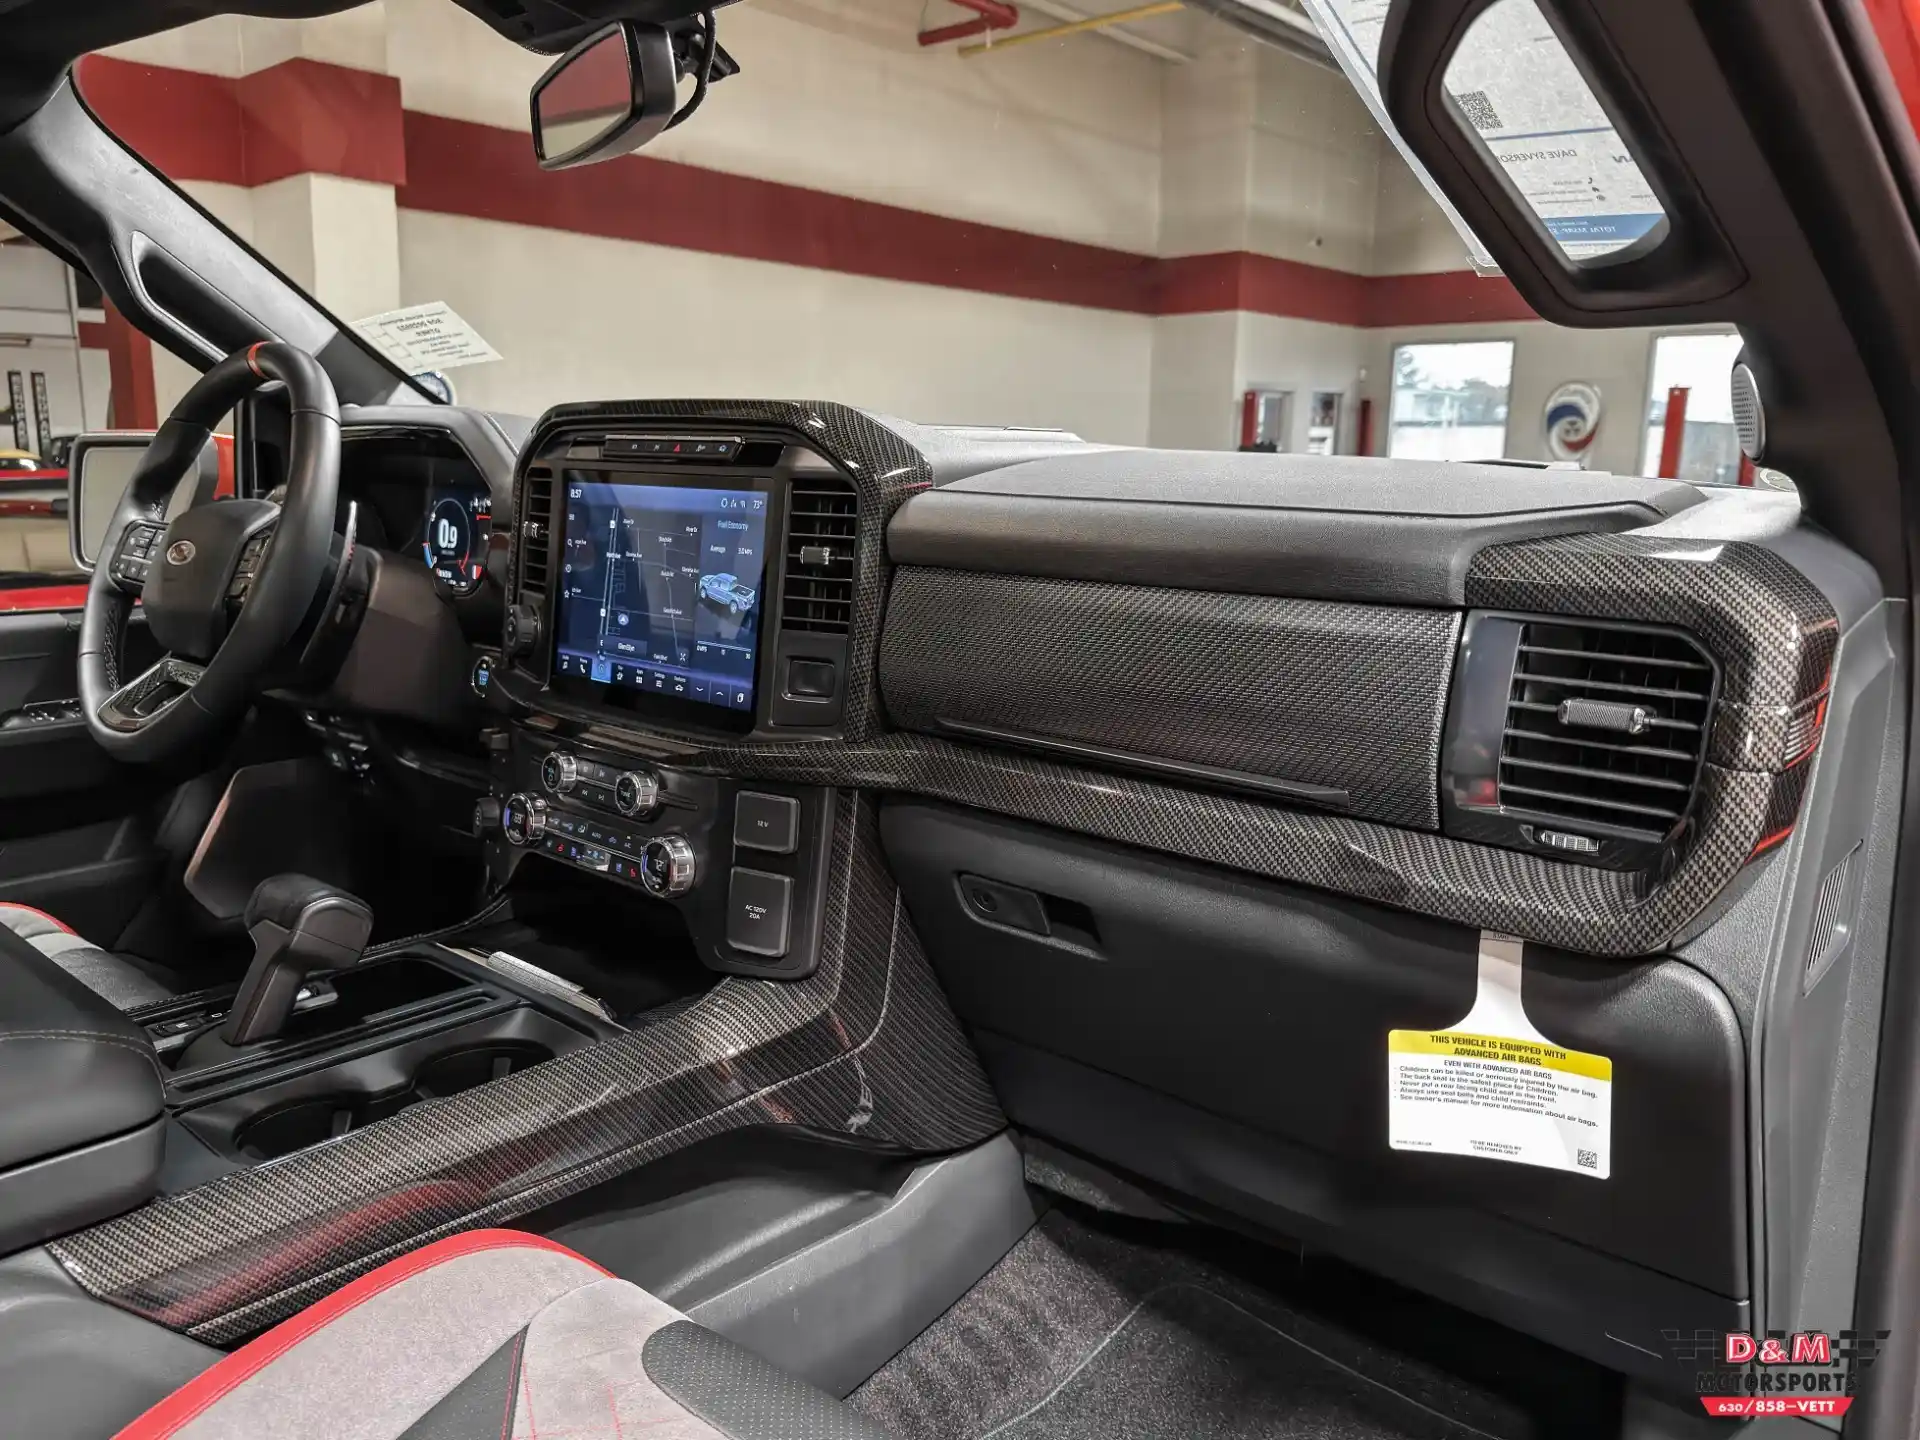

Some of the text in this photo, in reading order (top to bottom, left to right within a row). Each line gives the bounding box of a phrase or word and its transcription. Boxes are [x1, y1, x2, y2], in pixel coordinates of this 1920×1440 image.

[570, 488, 582, 499] 8:57
[438, 518, 458, 548] 0.9
[728, 520, 748, 532] Economy
[1430, 1035, 1450, 1044] THIS
[1452, 1037, 1486, 1048] VEHICLE
[1500, 1042, 1541, 1055] EQUIPPED
[1544, 1049, 1566, 1060] WITH
[1454, 1048, 1541, 1065] ADVANCED AIR BAGS
[1482, 1064, 1518, 1074] ADVANCED
[1534, 1071, 1552, 1079] BAGS
[1486, 1074, 1518, 1083] seriously
[1582, 1089, 1597, 1098] bag.
[1526, 1086, 1558, 1096] Children.
[1510, 1098, 1546, 1108] restraints.
[1503, 1103, 1543, 1114] information
[1545, 1110, 1565, 1119] about
[1578, 1117, 1598, 1127] bags.
